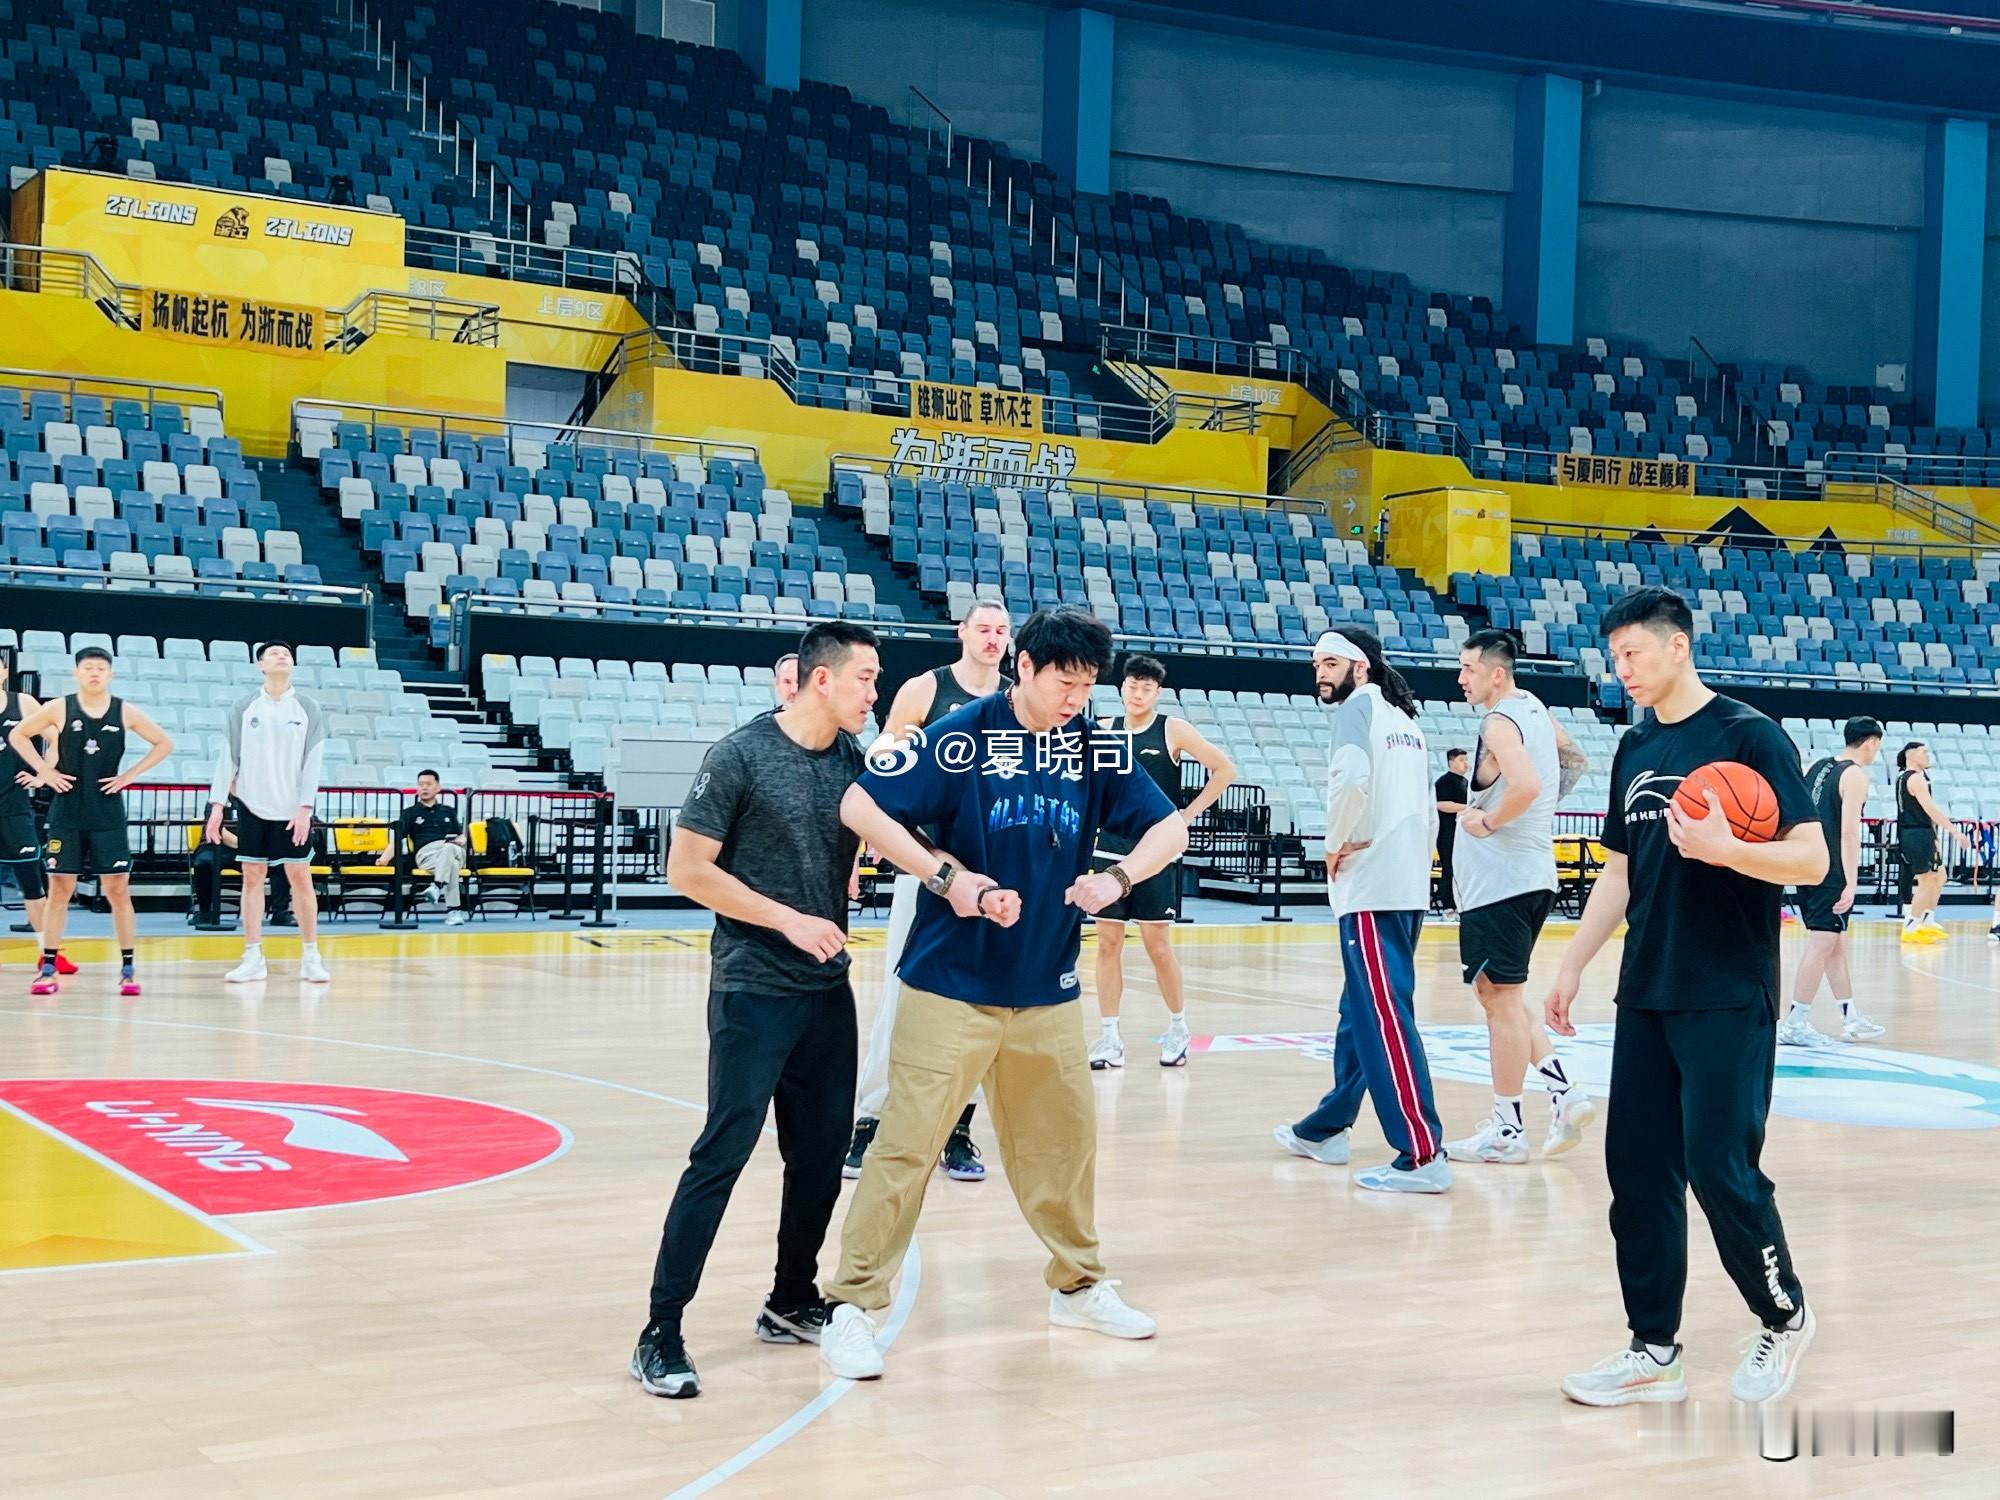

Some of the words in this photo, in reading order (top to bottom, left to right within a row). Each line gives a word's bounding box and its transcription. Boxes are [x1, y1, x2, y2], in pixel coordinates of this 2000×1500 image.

[152, 290, 229, 338] 扬帆起杭
[240, 302, 313, 350] 为浙而战
[537, 295, 605, 321] 上层9区
[917, 384, 973, 423] 雄狮出征
[979, 391, 1033, 428] 草木不生
[885, 428, 1077, 493] 为浙而战
[1562, 455, 1622, 485] 与厦同行
[1628, 460, 1690, 488] 战至巅峰
[84, 1100, 293, 1173] LI-NING
